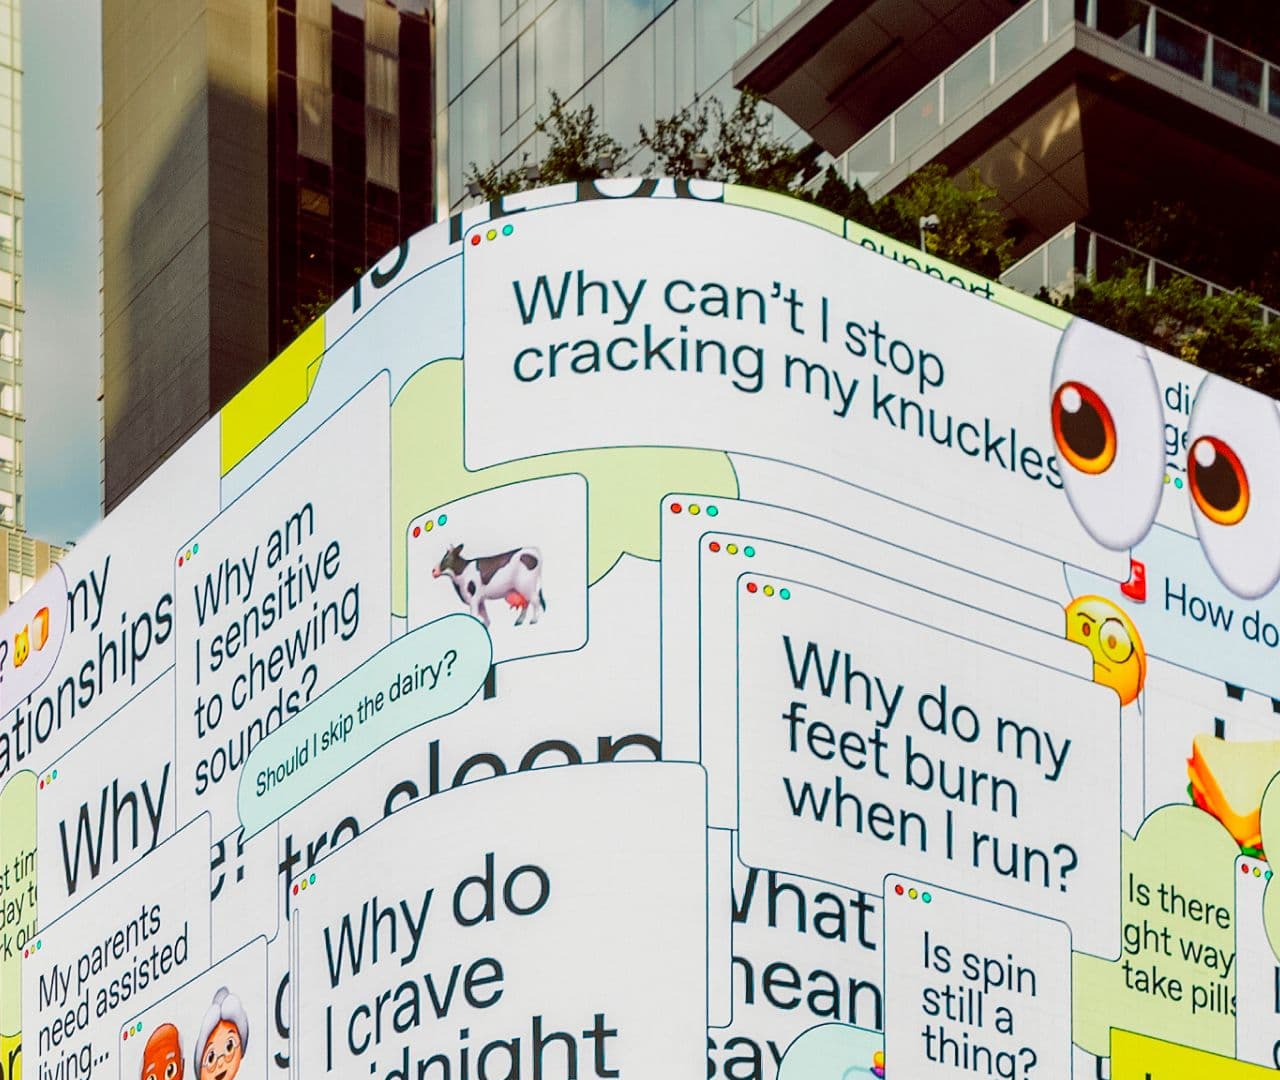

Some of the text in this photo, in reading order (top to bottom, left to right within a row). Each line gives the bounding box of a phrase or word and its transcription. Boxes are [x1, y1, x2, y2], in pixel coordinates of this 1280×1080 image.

[513, 267, 647, 327] Why
[842, 314, 945, 392] stop
[513, 321, 1063, 490] cracking my knuckles
[194, 502, 314, 627] Why am
[209, 540, 341, 673] sensitive
[1165, 576, 1280, 648] How do
[195, 582, 360, 739] to chewing
[780, 634, 1073, 782] Why do my
[256, 649, 458, 799] Should skip the dairy?
[782, 705, 1019, 817] feet burn
[59, 762, 171, 898] Why
[782, 774, 1079, 895] when run?
[39, 904, 161, 1011] My parents
[322, 851, 551, 988] Why do
[1129, 873, 1231, 929] Is there
[1179, 939, 1236, 978] way
[39, 921, 189, 1057] need assisted
[347, 953, 505, 1057] crave
[922, 931, 1039, 1009] Is spin
[922, 982, 983, 1031] still
[1122, 961, 1183, 1002] take
